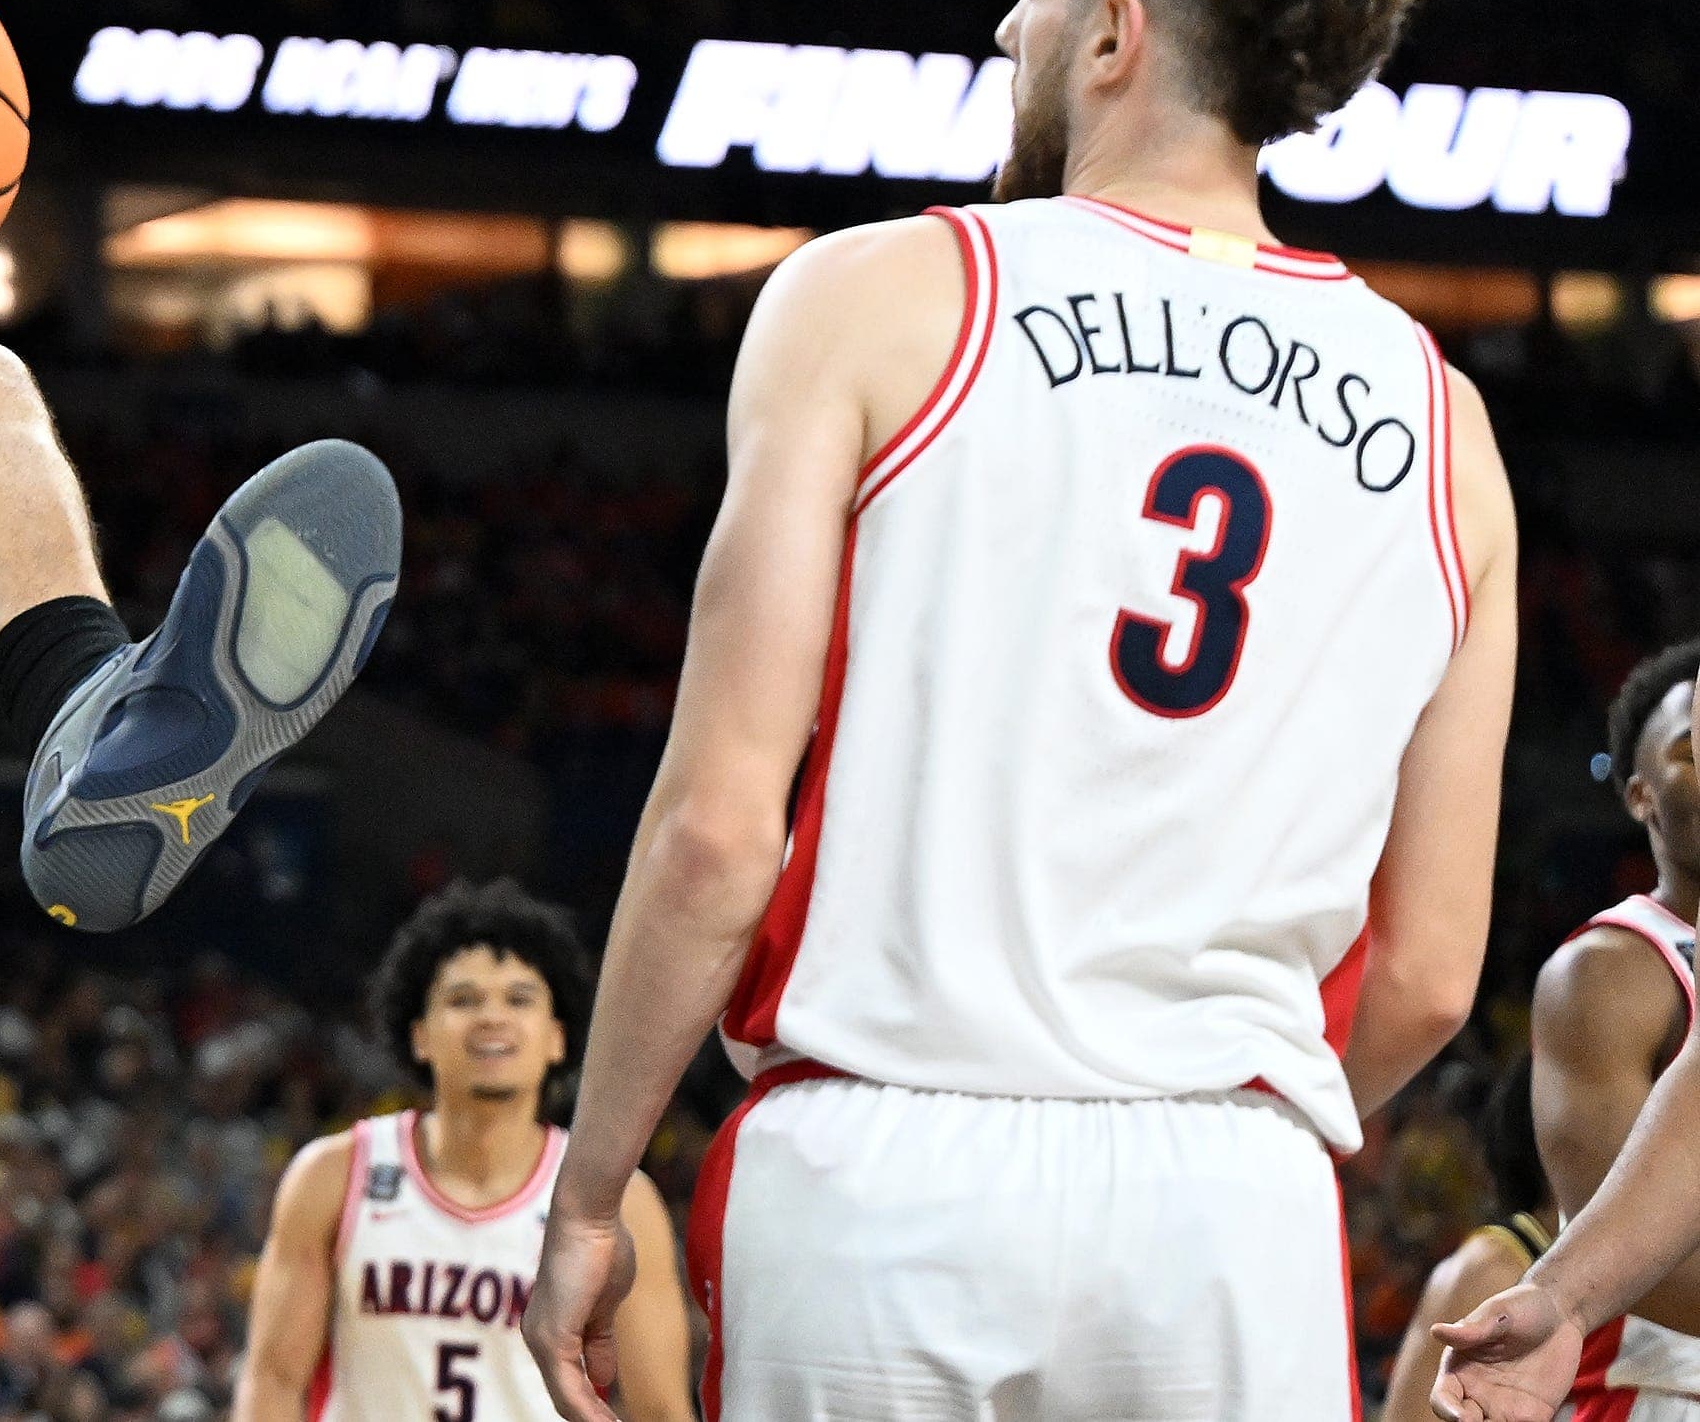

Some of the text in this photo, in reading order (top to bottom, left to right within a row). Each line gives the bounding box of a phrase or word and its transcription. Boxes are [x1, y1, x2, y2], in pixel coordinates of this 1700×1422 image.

[655, 38, 1014, 182] FINA
[1260, 80, 1630, 218] OUR
[1012, 291, 1416, 492] DELL'ORSO
[1109, 442, 1274, 719] 3
[360, 1260, 534, 1328] ARIZON
[433, 1341, 480, 1422] 5
